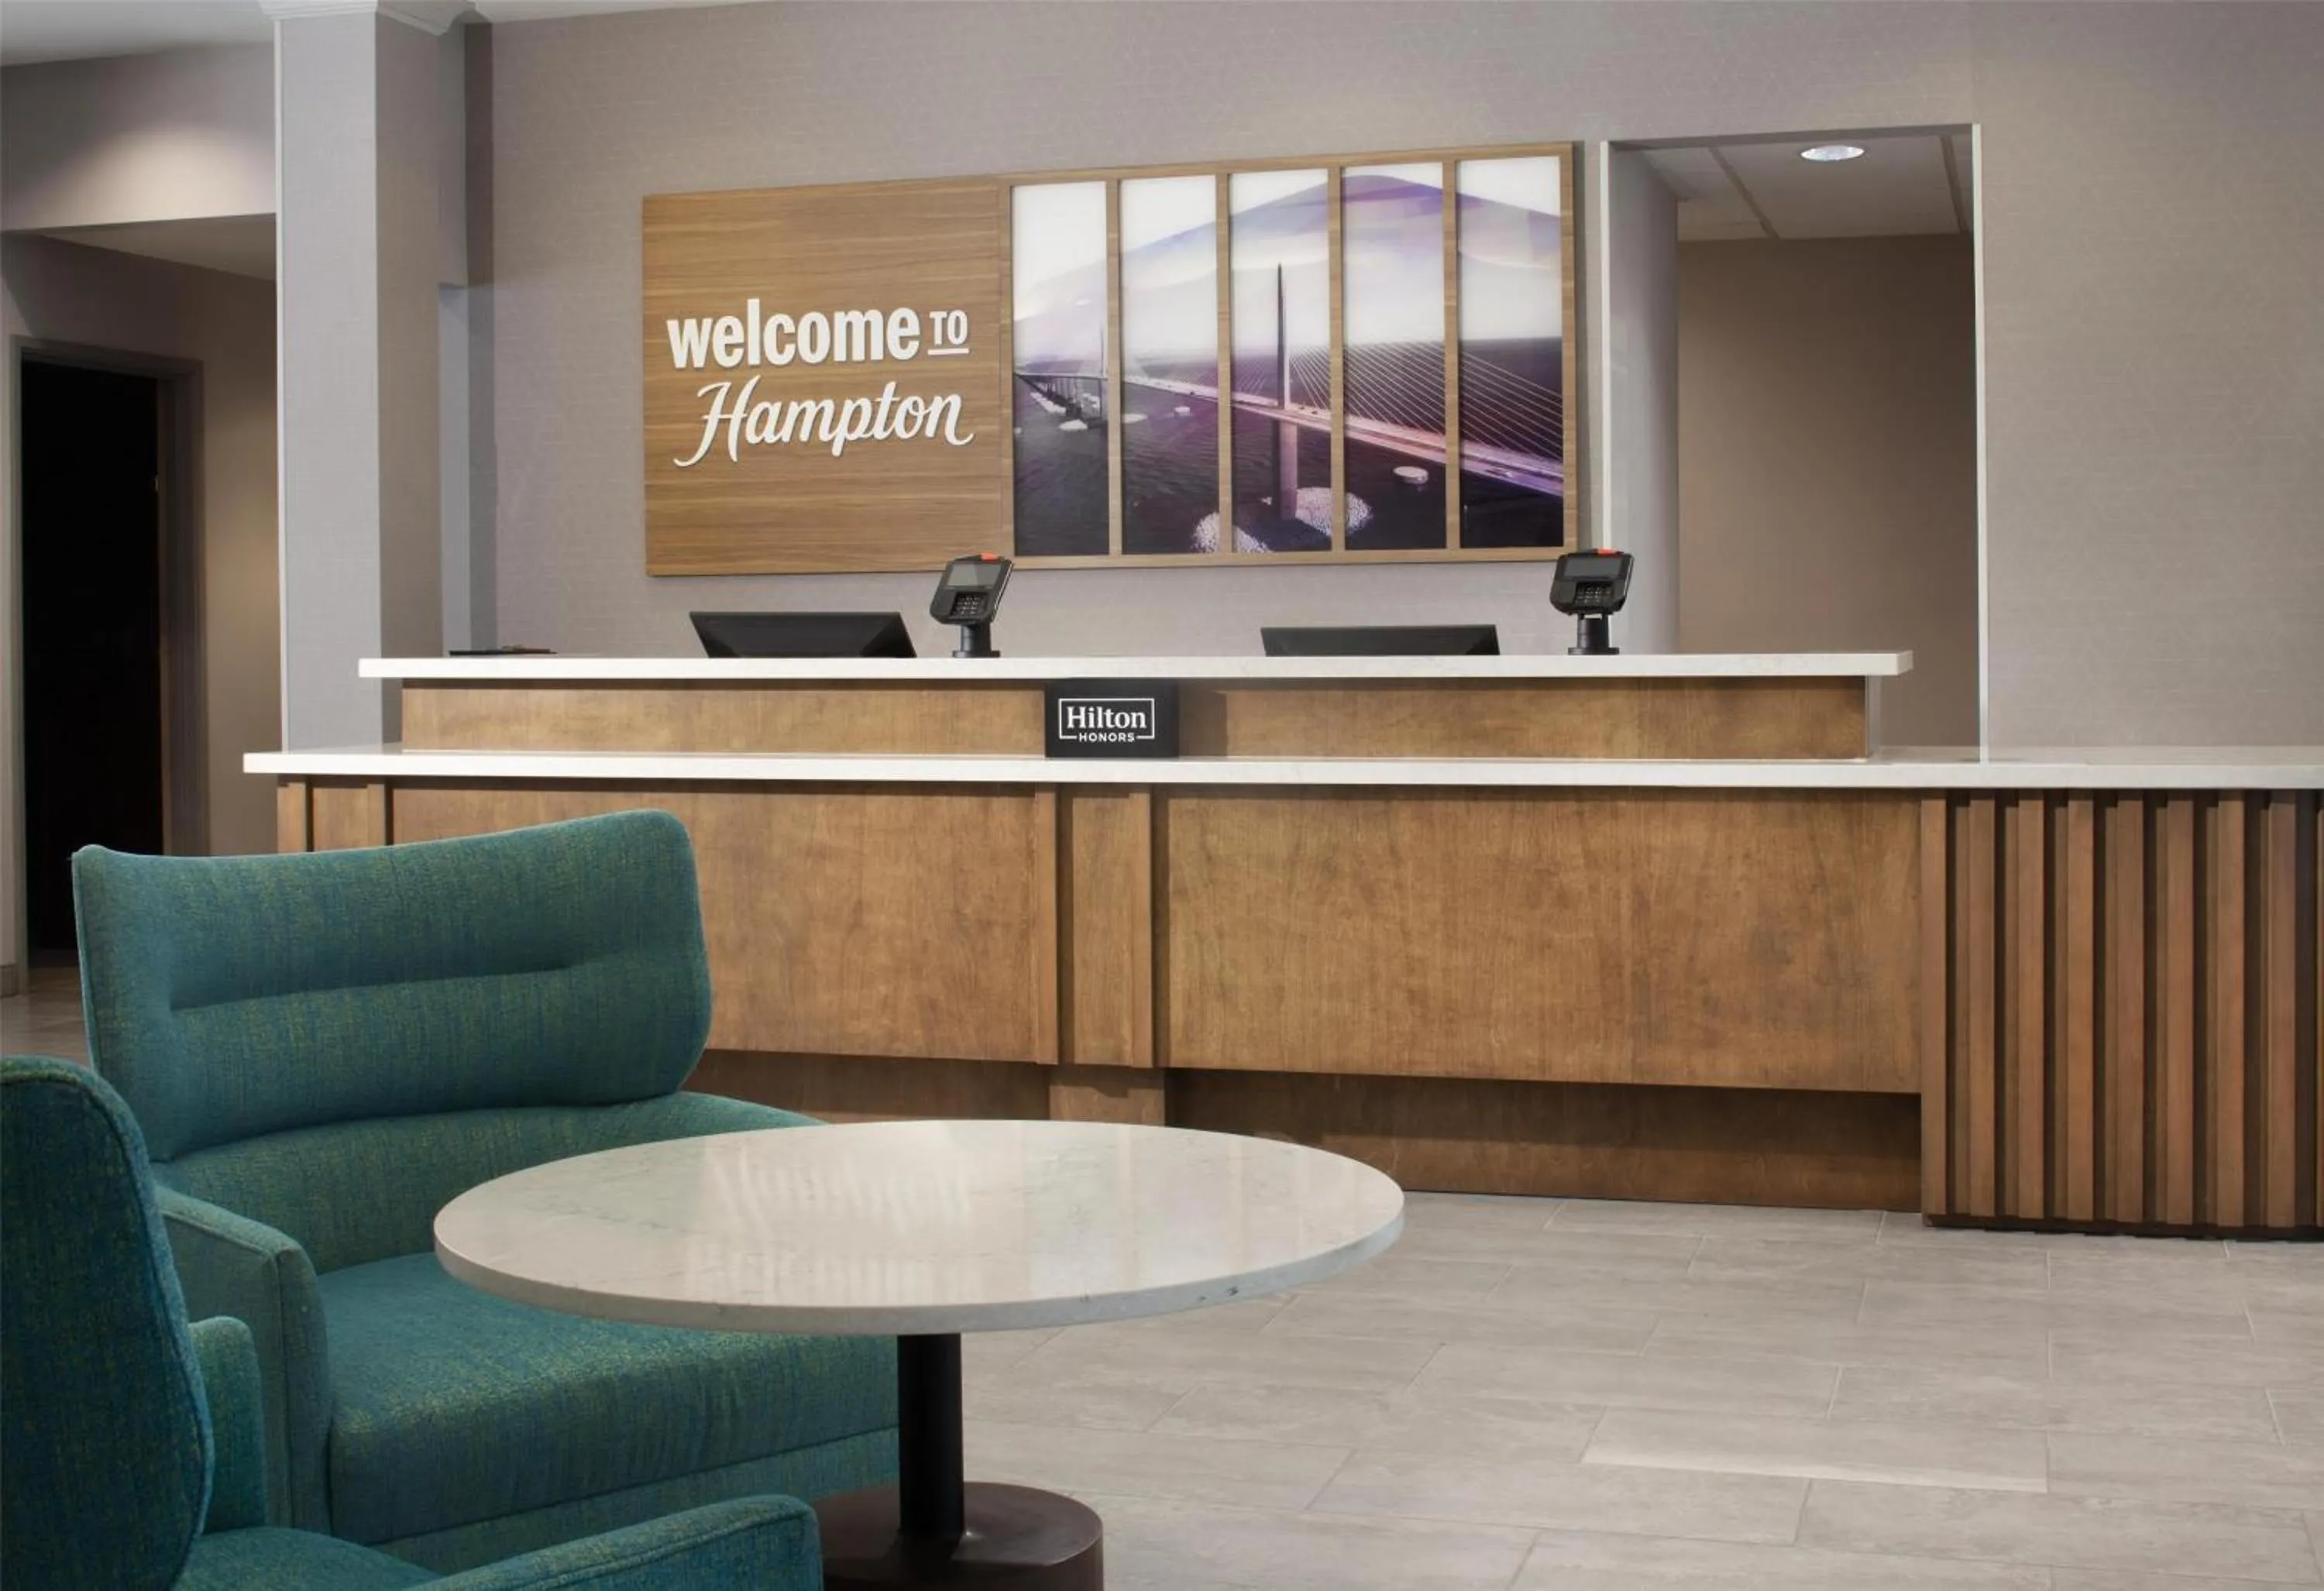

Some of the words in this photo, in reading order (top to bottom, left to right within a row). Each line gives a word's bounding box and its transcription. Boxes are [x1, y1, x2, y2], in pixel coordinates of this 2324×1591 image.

[666, 298, 920, 369] welcome
[929, 309, 968, 346] TO
[673, 374, 974, 467] Hampton
[1067, 706, 1147, 729] Hilton
[1078, 732, 1135, 743] HONORS
